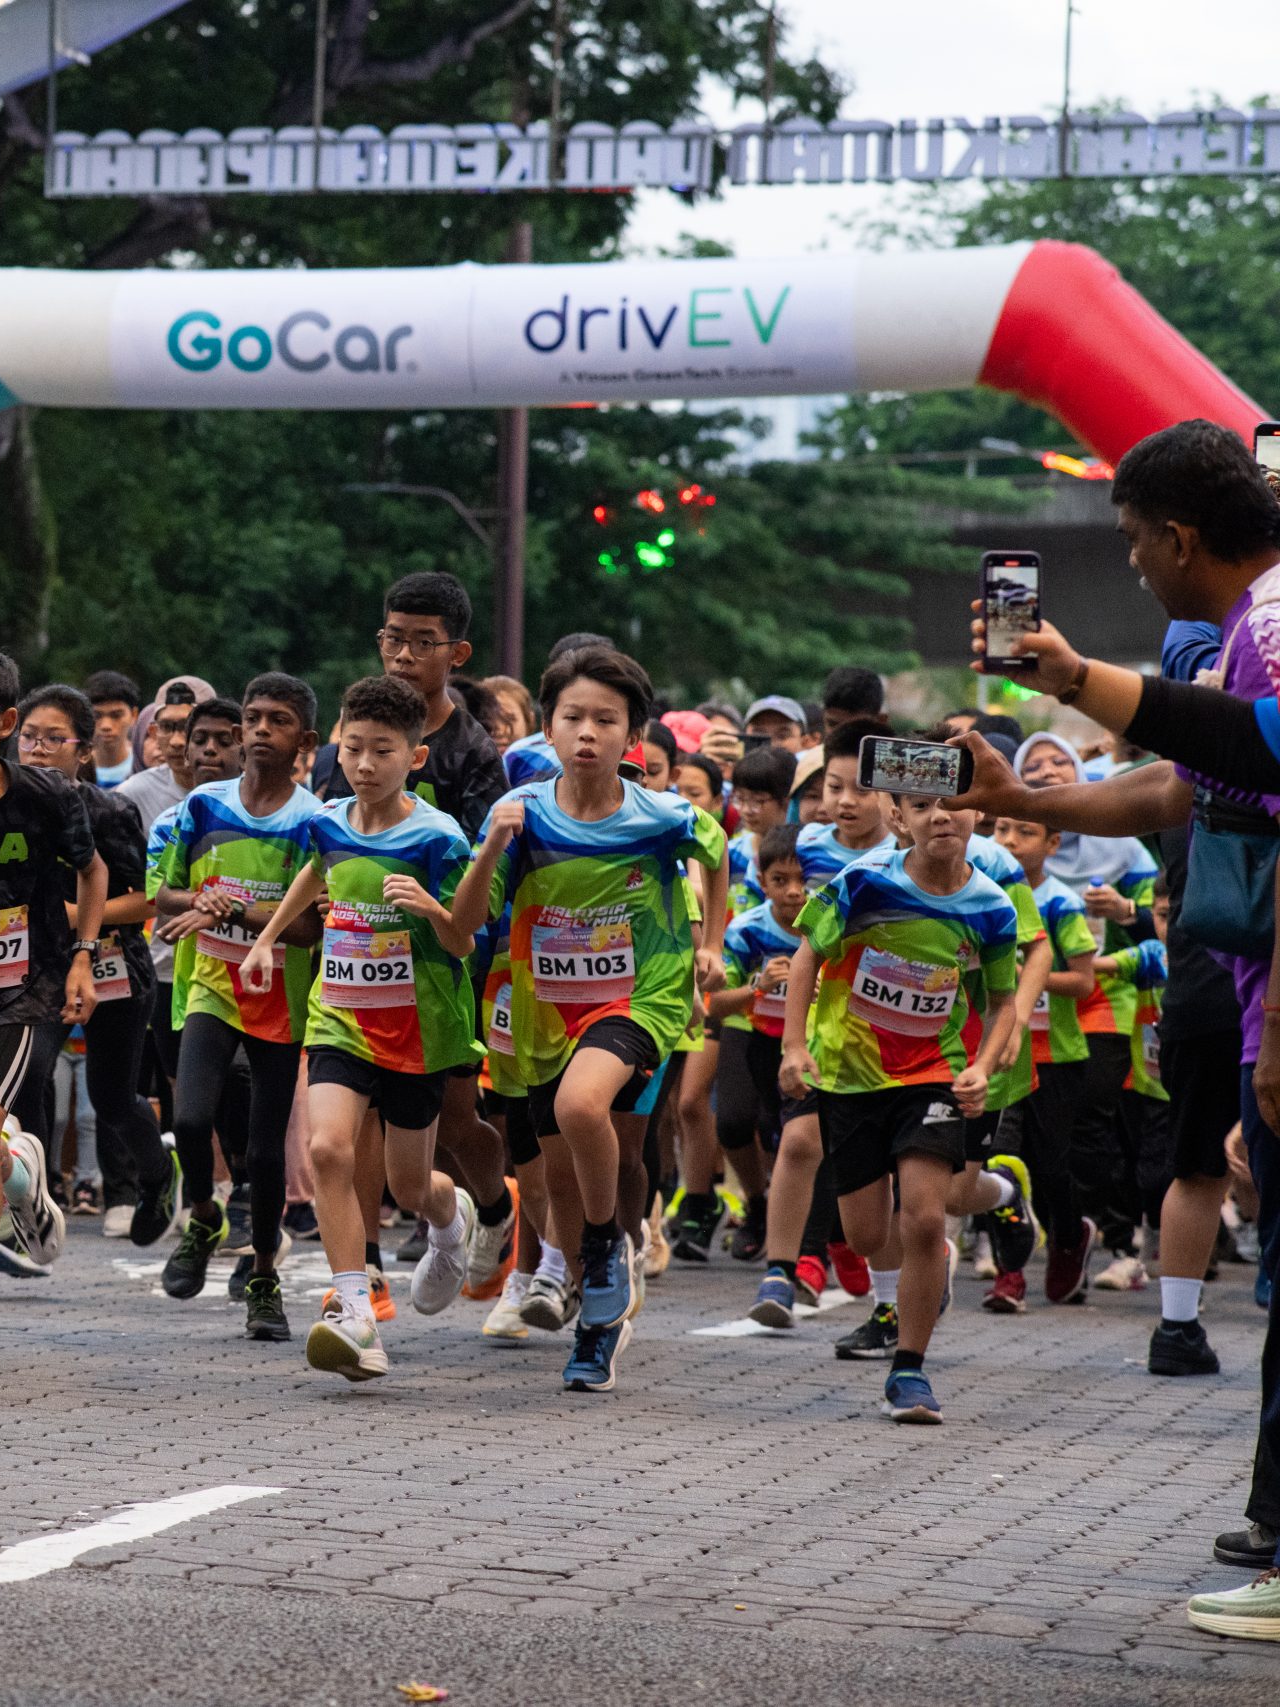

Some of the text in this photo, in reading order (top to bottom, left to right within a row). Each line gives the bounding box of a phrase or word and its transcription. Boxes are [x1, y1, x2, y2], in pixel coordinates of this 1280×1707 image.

[524, 285, 791, 353] drivEV
[167, 310, 413, 373] GoCar
[219, 875, 283, 890] MALAYSIA
[333, 900, 396, 913] MALAYSIA
[541, 903, 628, 917] MALAYSIA
[92, 961, 118, 980] 65
[325, 959, 410, 982] BM 092
[538, 954, 627, 976] BM 103
[861, 977, 948, 1014] BM 132
